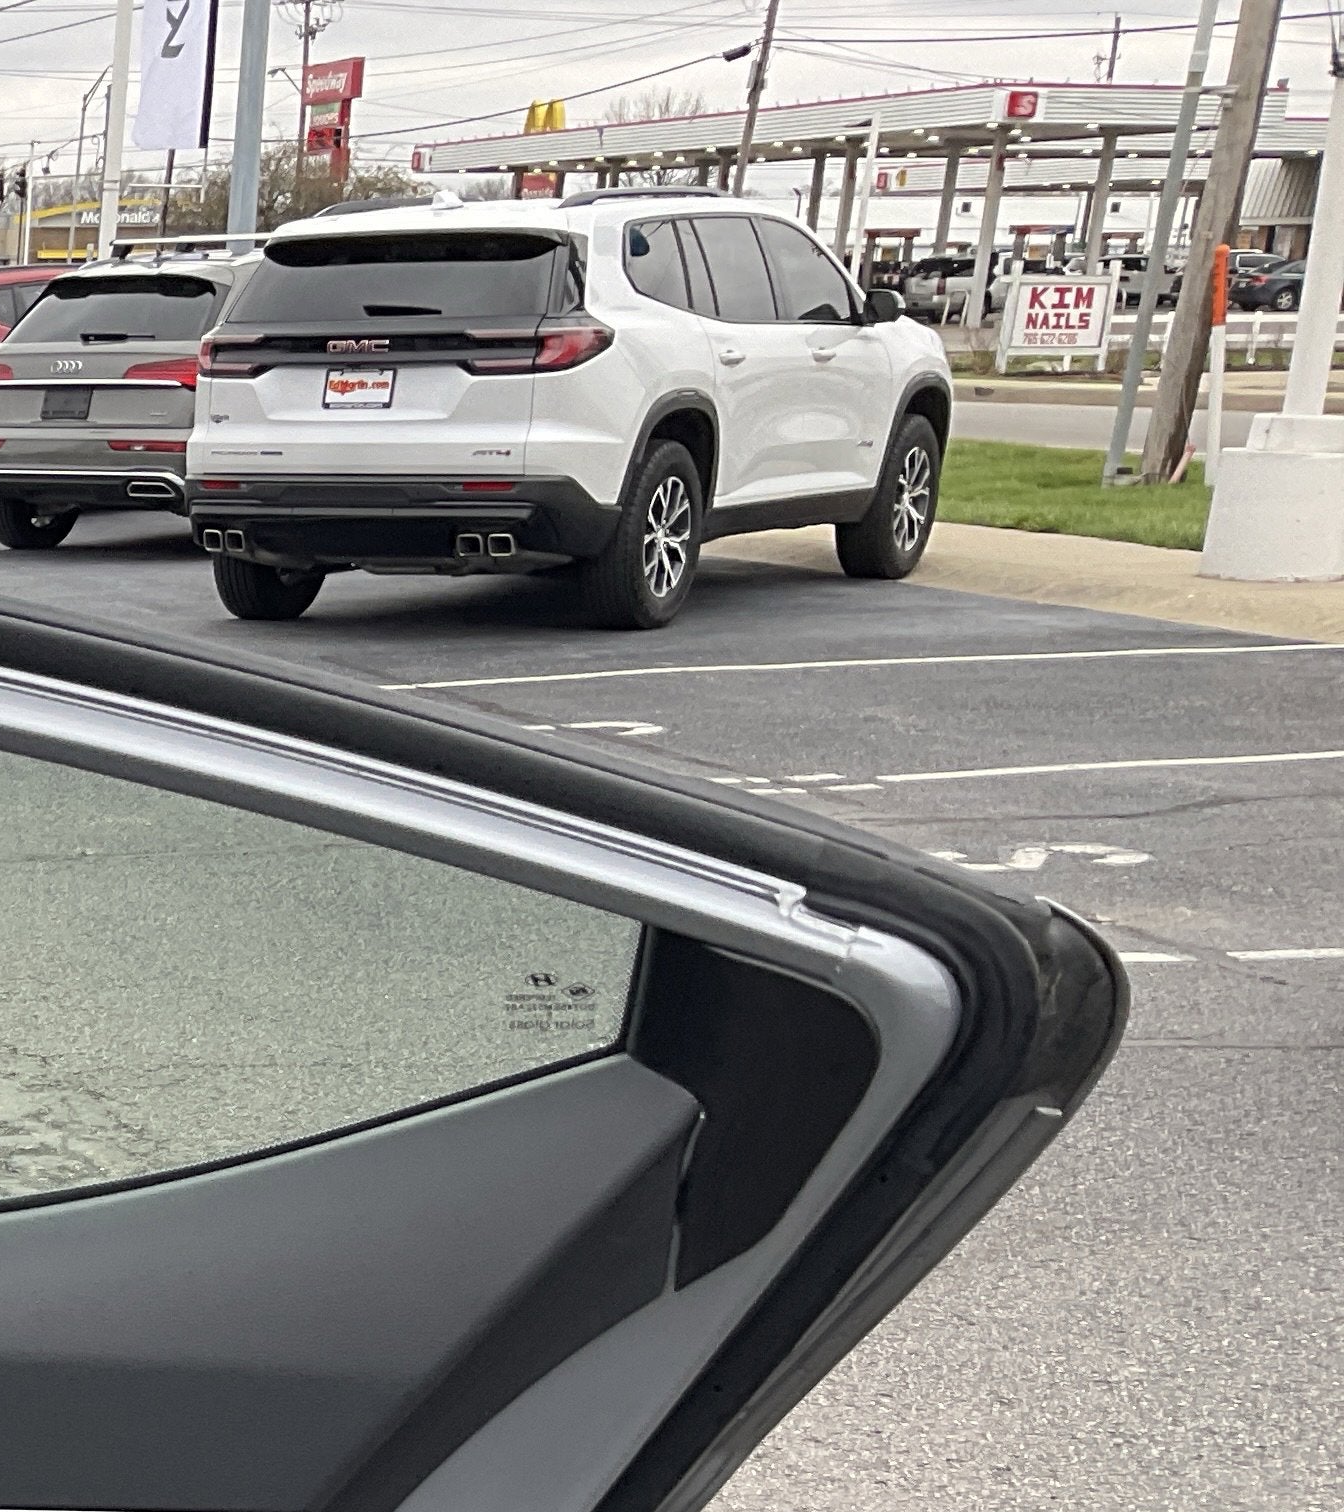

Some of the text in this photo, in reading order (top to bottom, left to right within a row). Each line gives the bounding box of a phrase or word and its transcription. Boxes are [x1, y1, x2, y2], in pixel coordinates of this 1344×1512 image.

[1028, 286, 1095, 309] KIM
[1025, 312, 1091, 330] NAILS
[327, 339, 390, 353] GMC
